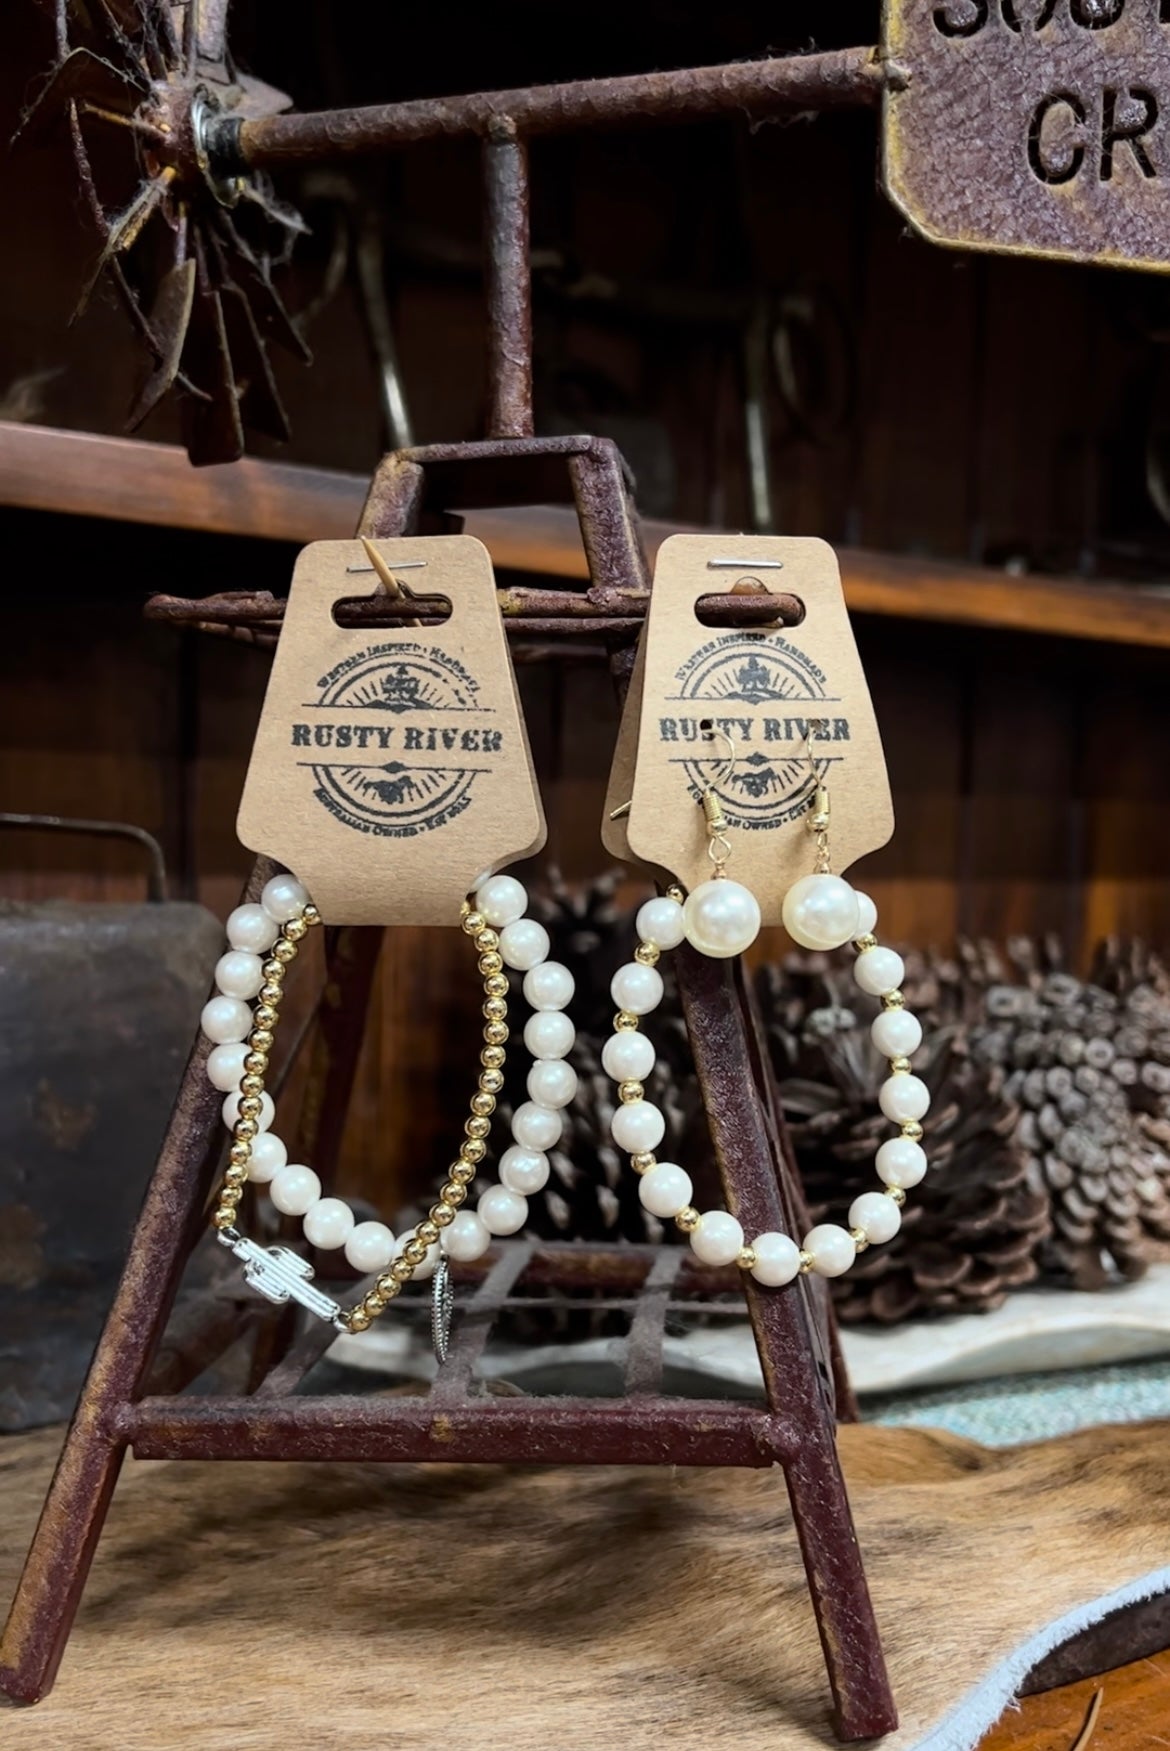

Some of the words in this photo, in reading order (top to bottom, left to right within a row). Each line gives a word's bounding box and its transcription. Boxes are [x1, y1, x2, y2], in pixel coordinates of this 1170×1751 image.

[291, 723, 395, 748] RUSTY
[403, 726, 503, 752] RIVER
[763, 718, 850, 741] RIVER
